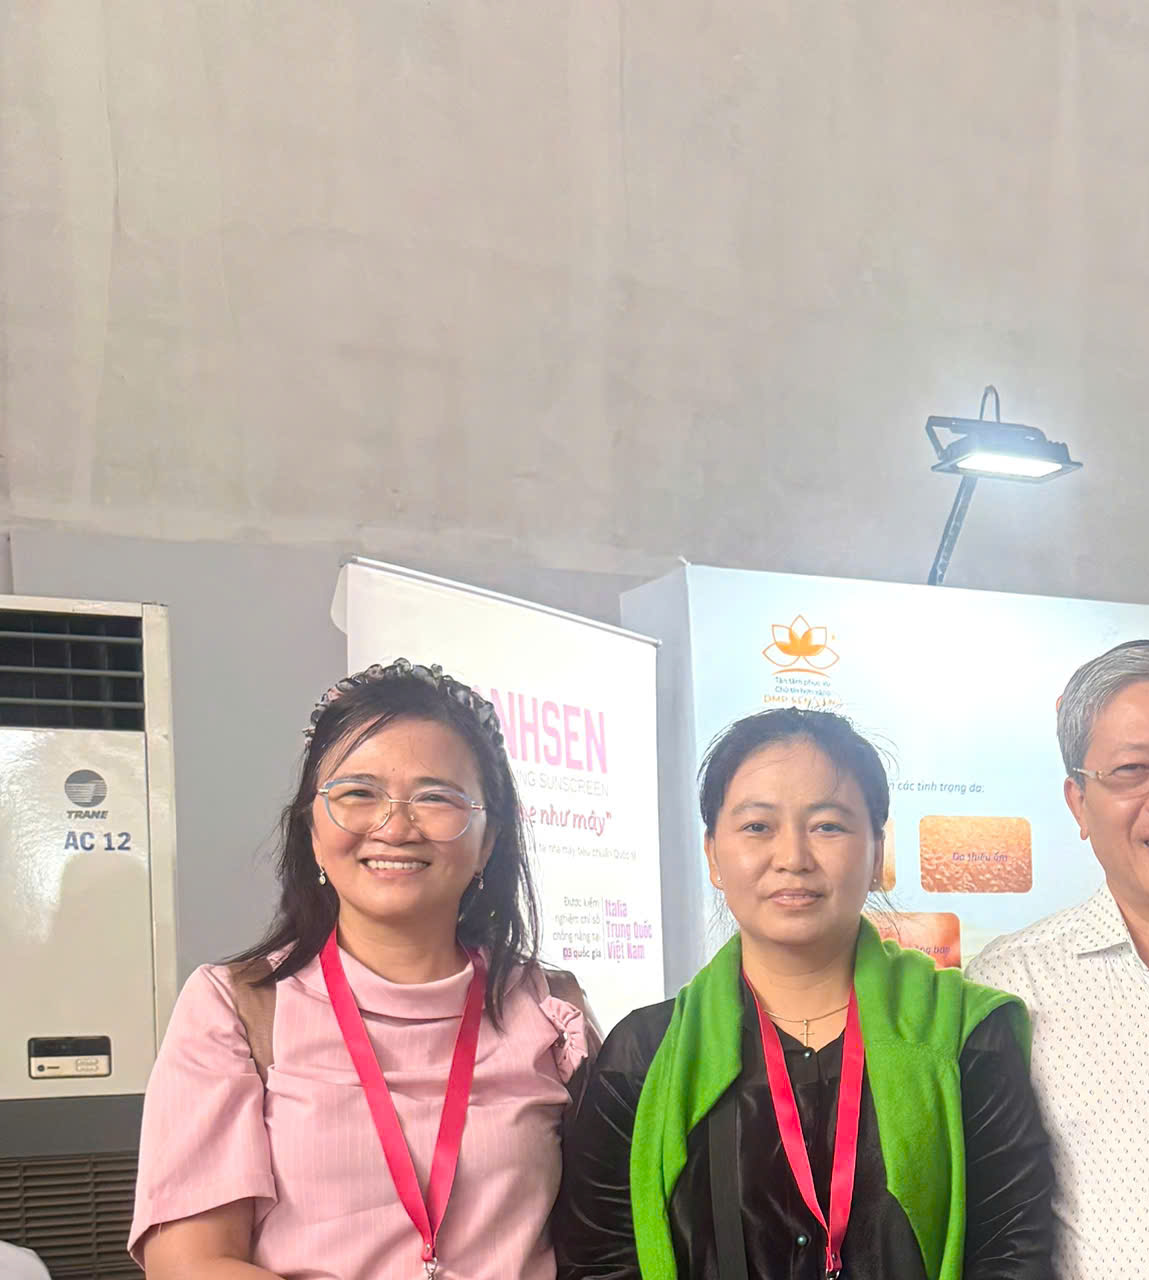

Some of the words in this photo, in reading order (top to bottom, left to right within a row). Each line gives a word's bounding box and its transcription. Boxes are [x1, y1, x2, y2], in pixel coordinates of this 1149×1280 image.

[473, 685, 607, 774] NHSEN
[539, 772, 609, 797] SUNSCREEN
[898, 780, 914, 791] các
[66, 810, 108, 820] TRANE
[64, 831, 95, 852] AC
[103, 832, 131, 852] 12
[605, 898, 627, 917] Italia
[606, 920, 631, 940] Trung
[633, 919, 653, 939] Quốc
[607, 940, 625, 963] Việt
[627, 942, 645, 960] Nam
